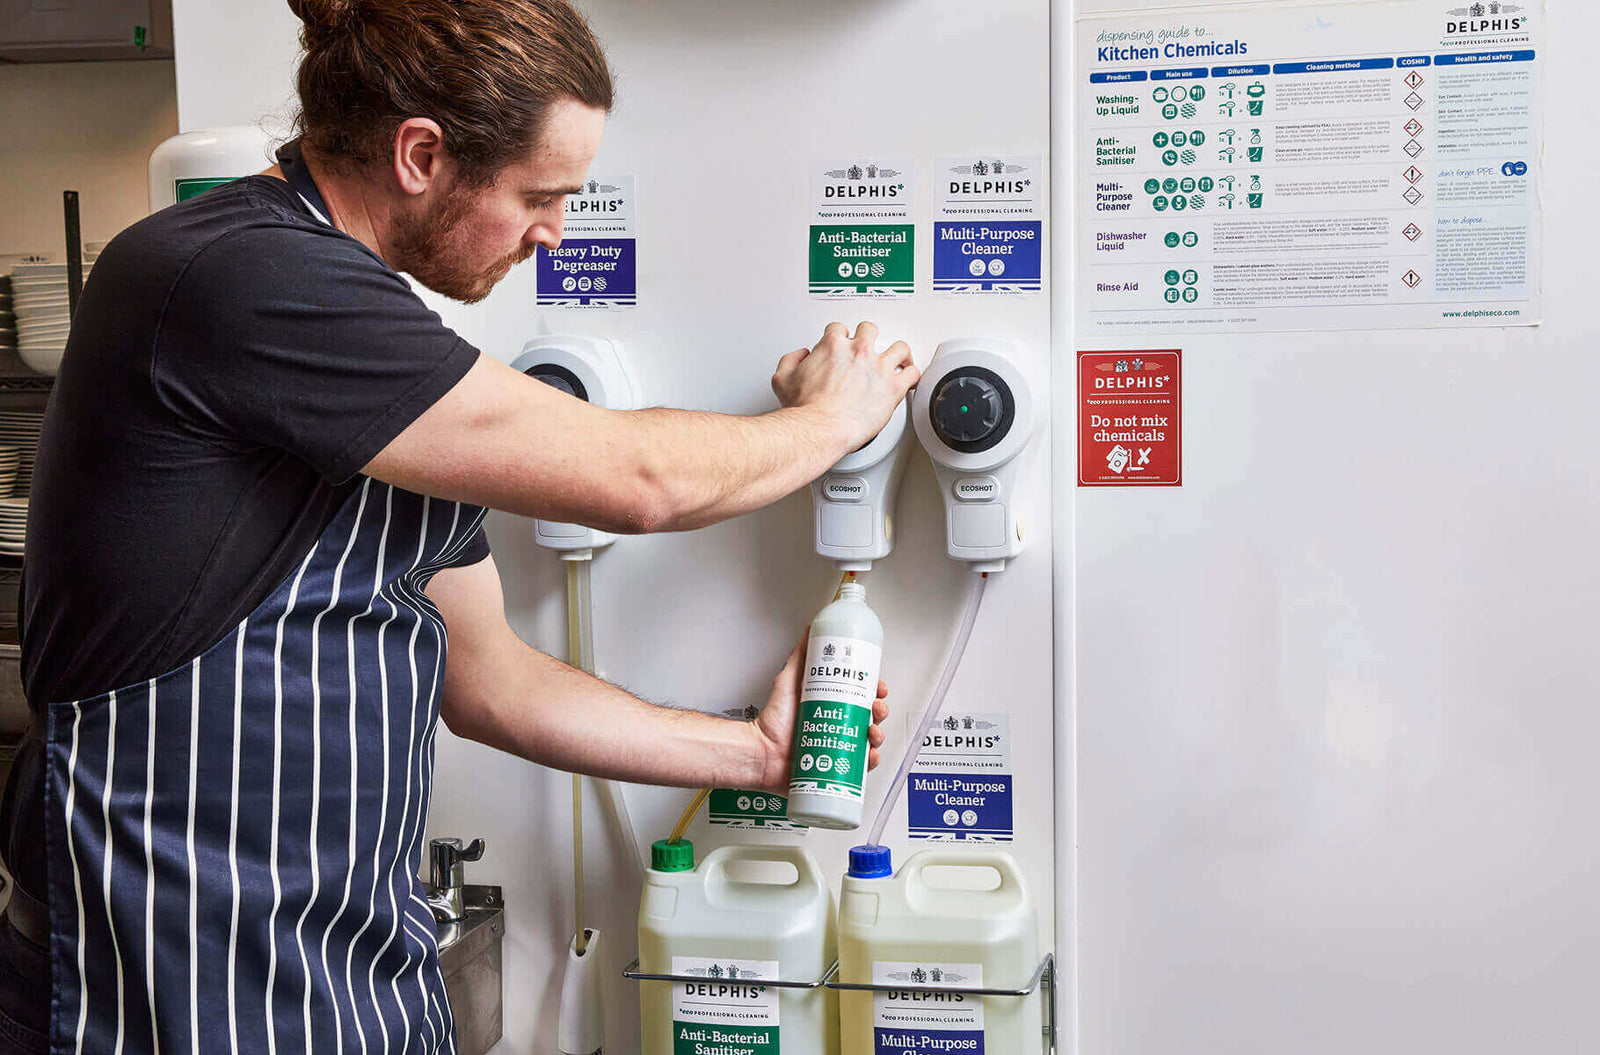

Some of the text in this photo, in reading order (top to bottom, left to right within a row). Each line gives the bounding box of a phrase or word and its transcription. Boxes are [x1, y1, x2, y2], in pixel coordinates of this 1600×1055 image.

[1096, 29, 1154, 45] dispensing
[1158, 25, 1190, 44] guide
[1098, 40, 1247, 61] Kitchen Chemicals
[1455, 55, 1477, 63] Health
[1491, 53, 1513, 61] safety
[1306, 63, 1334, 71] Cleaning
[1096, 94, 1139, 105] Washing-
[1096, 105, 1139, 117] Up Liquid
[1096, 136, 1120, 146] Anti-
[1096, 146, 1136, 156] Bacterial
[1096, 156, 1135, 166] Sanitiser
[1096, 182, 1123, 192] Multi-
[1096, 193, 1133, 203] Purpose
[1096, 202, 1131, 212] Cleaner
[818, 231, 907, 244] Anti-Bacterial
[941, 227, 1035, 242] Multi-Purpose
[1096, 231, 1147, 241] Dishwasher
[548, 245, 622, 260] Heavy Duty
[833, 245, 892, 258] Sanitiser
[961, 242, 1014, 255] Cleaner
[1096, 242, 1125, 252] Liquid
[553, 260, 618, 274] Degreaser
[1096, 282, 1139, 292] Rinse Aid
[1442, 309, 1520, 319] www.delphiseco.com
[1090, 414, 1168, 428] Do not mix
[1093, 429, 1165, 442] chemicals
[829, 484, 862, 493] ECOSHOT
[960, 484, 993, 492] ECOSHOT
[813, 706, 849, 720] Anti-
[802, 721, 859, 738] Bacterial
[800, 735, 857, 753] Sanitiser
[914, 778, 1005, 794] Multi-Purpose
[935, 793, 986, 806] Cleaner
[680, 1028, 770, 1044] Anti-Bacterial
[881, 1034, 977, 1051] Multi-Purpose
[695, 1043, 754, 1055] Sanitiser
